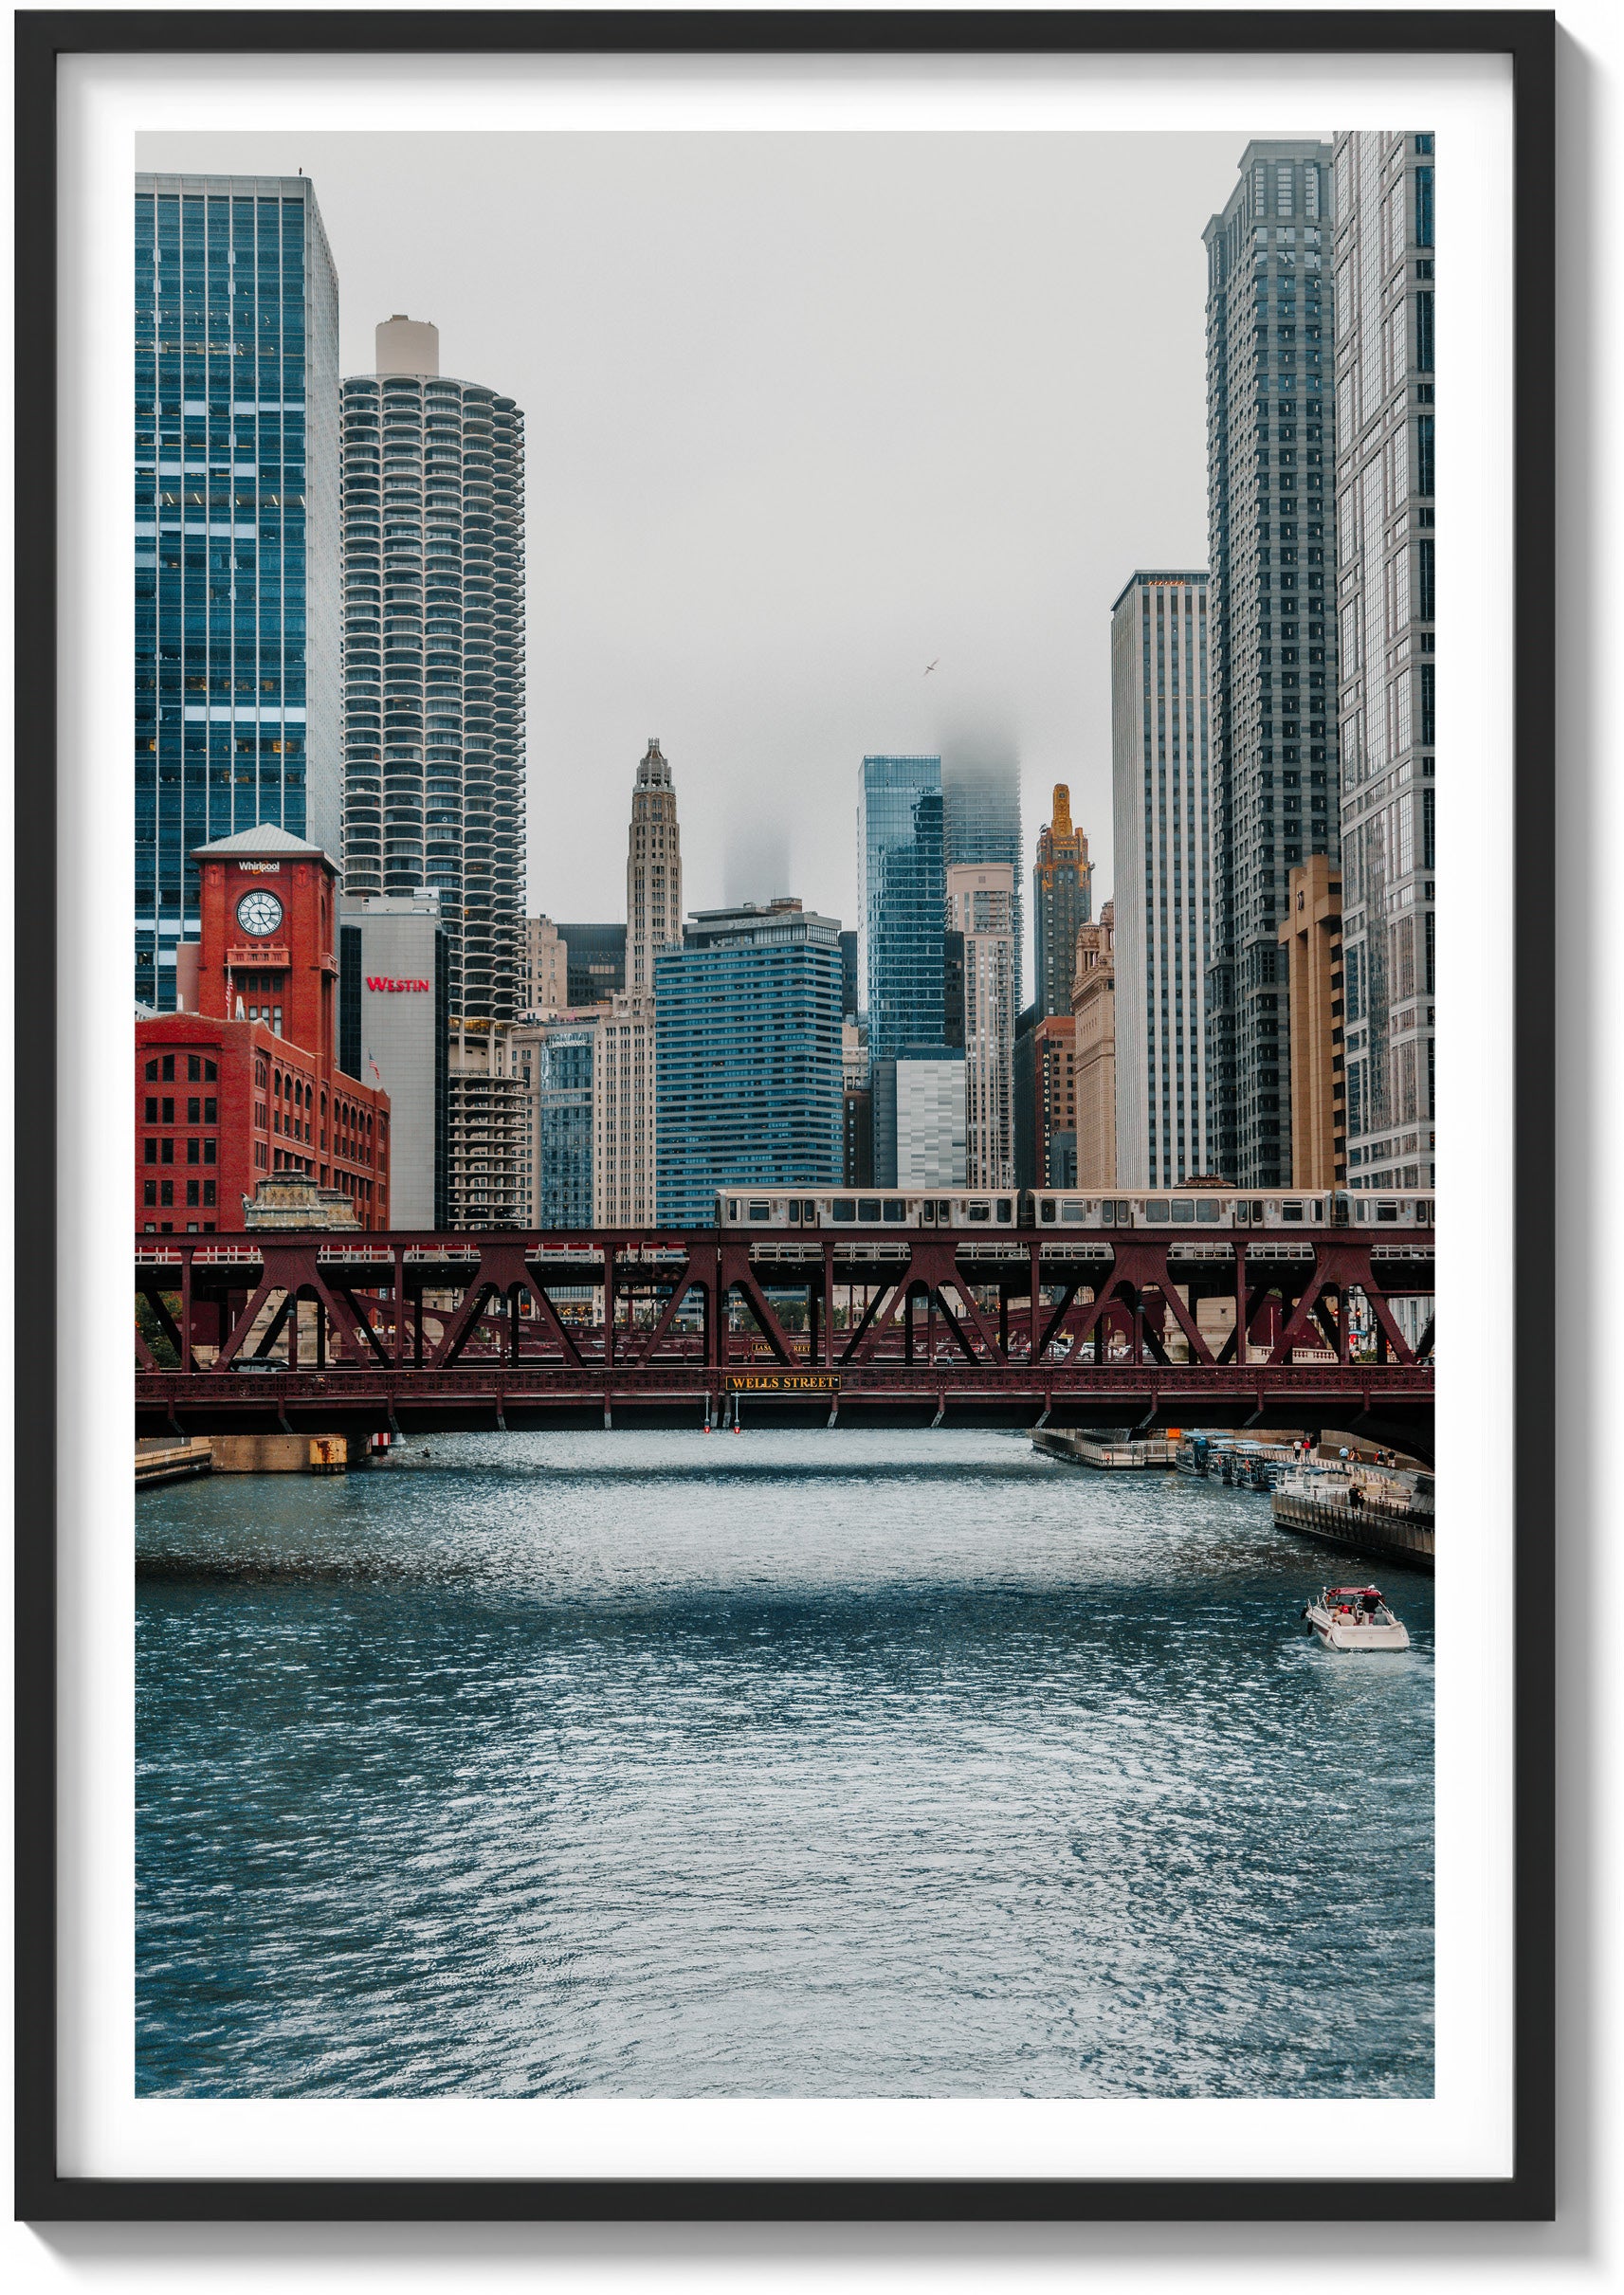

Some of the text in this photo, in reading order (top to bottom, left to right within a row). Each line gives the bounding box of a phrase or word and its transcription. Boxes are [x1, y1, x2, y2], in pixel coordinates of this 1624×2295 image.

[239, 862, 280, 872] Whirlpool
[732, 1376, 834, 1389] WELLS STREET
